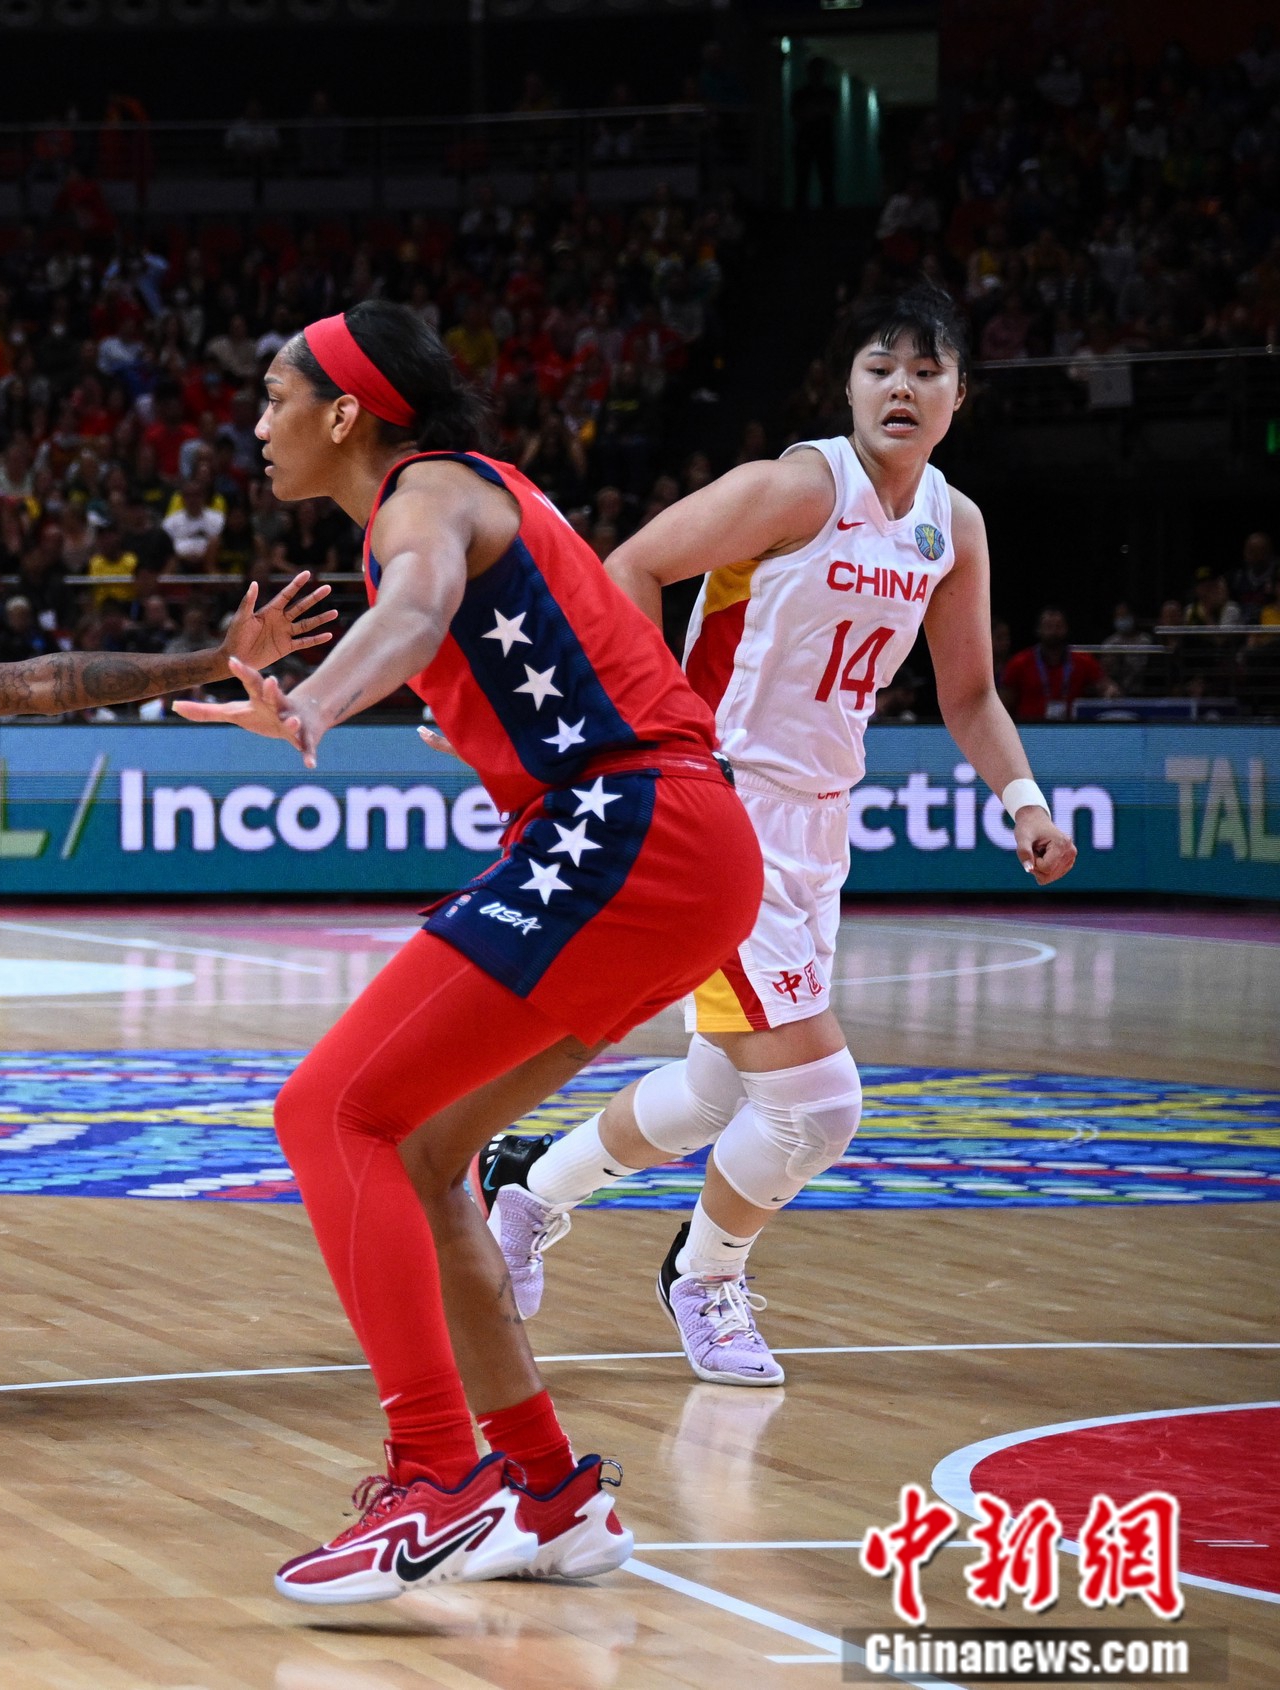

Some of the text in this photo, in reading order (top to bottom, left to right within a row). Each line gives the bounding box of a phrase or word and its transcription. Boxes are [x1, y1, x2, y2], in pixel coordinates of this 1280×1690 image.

[826, 560, 929, 603] CHINA
[815, 620, 896, 710] 14
[121, 769, 504, 852] Income
[1165, 755, 1280, 863] TAL
[479, 902, 542, 936] USA
